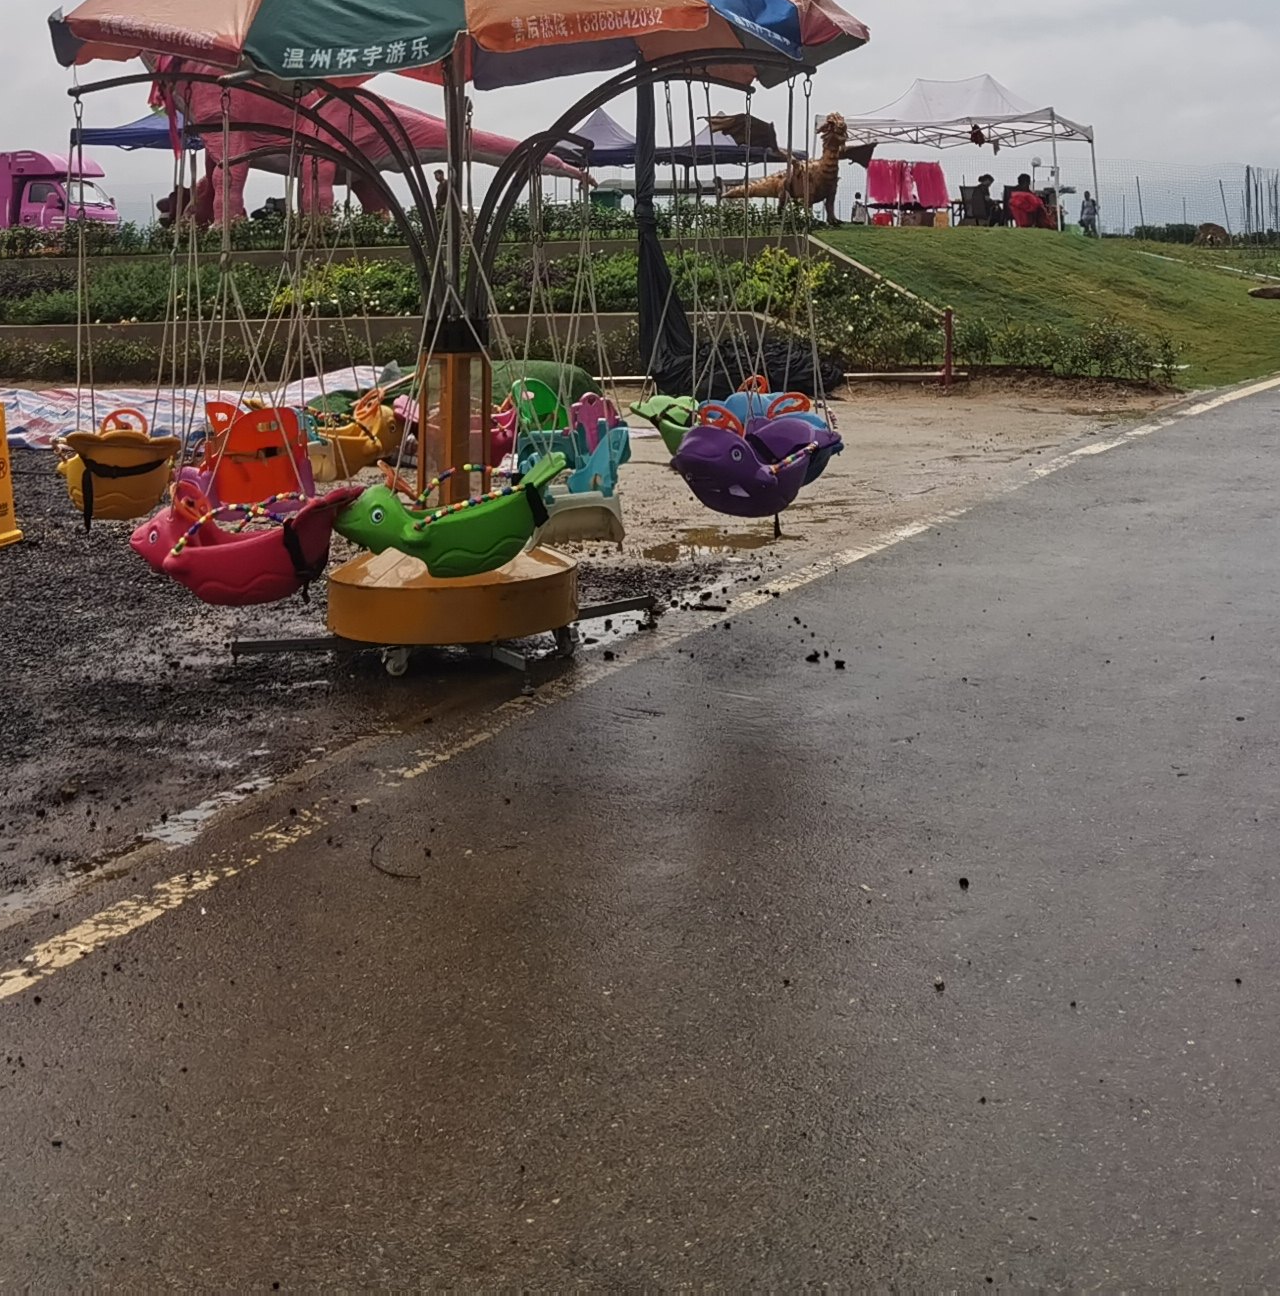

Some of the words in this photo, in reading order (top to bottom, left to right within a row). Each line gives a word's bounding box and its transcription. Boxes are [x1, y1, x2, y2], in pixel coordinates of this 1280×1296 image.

[282, 36, 430, 70] 温州怀宇游乐
